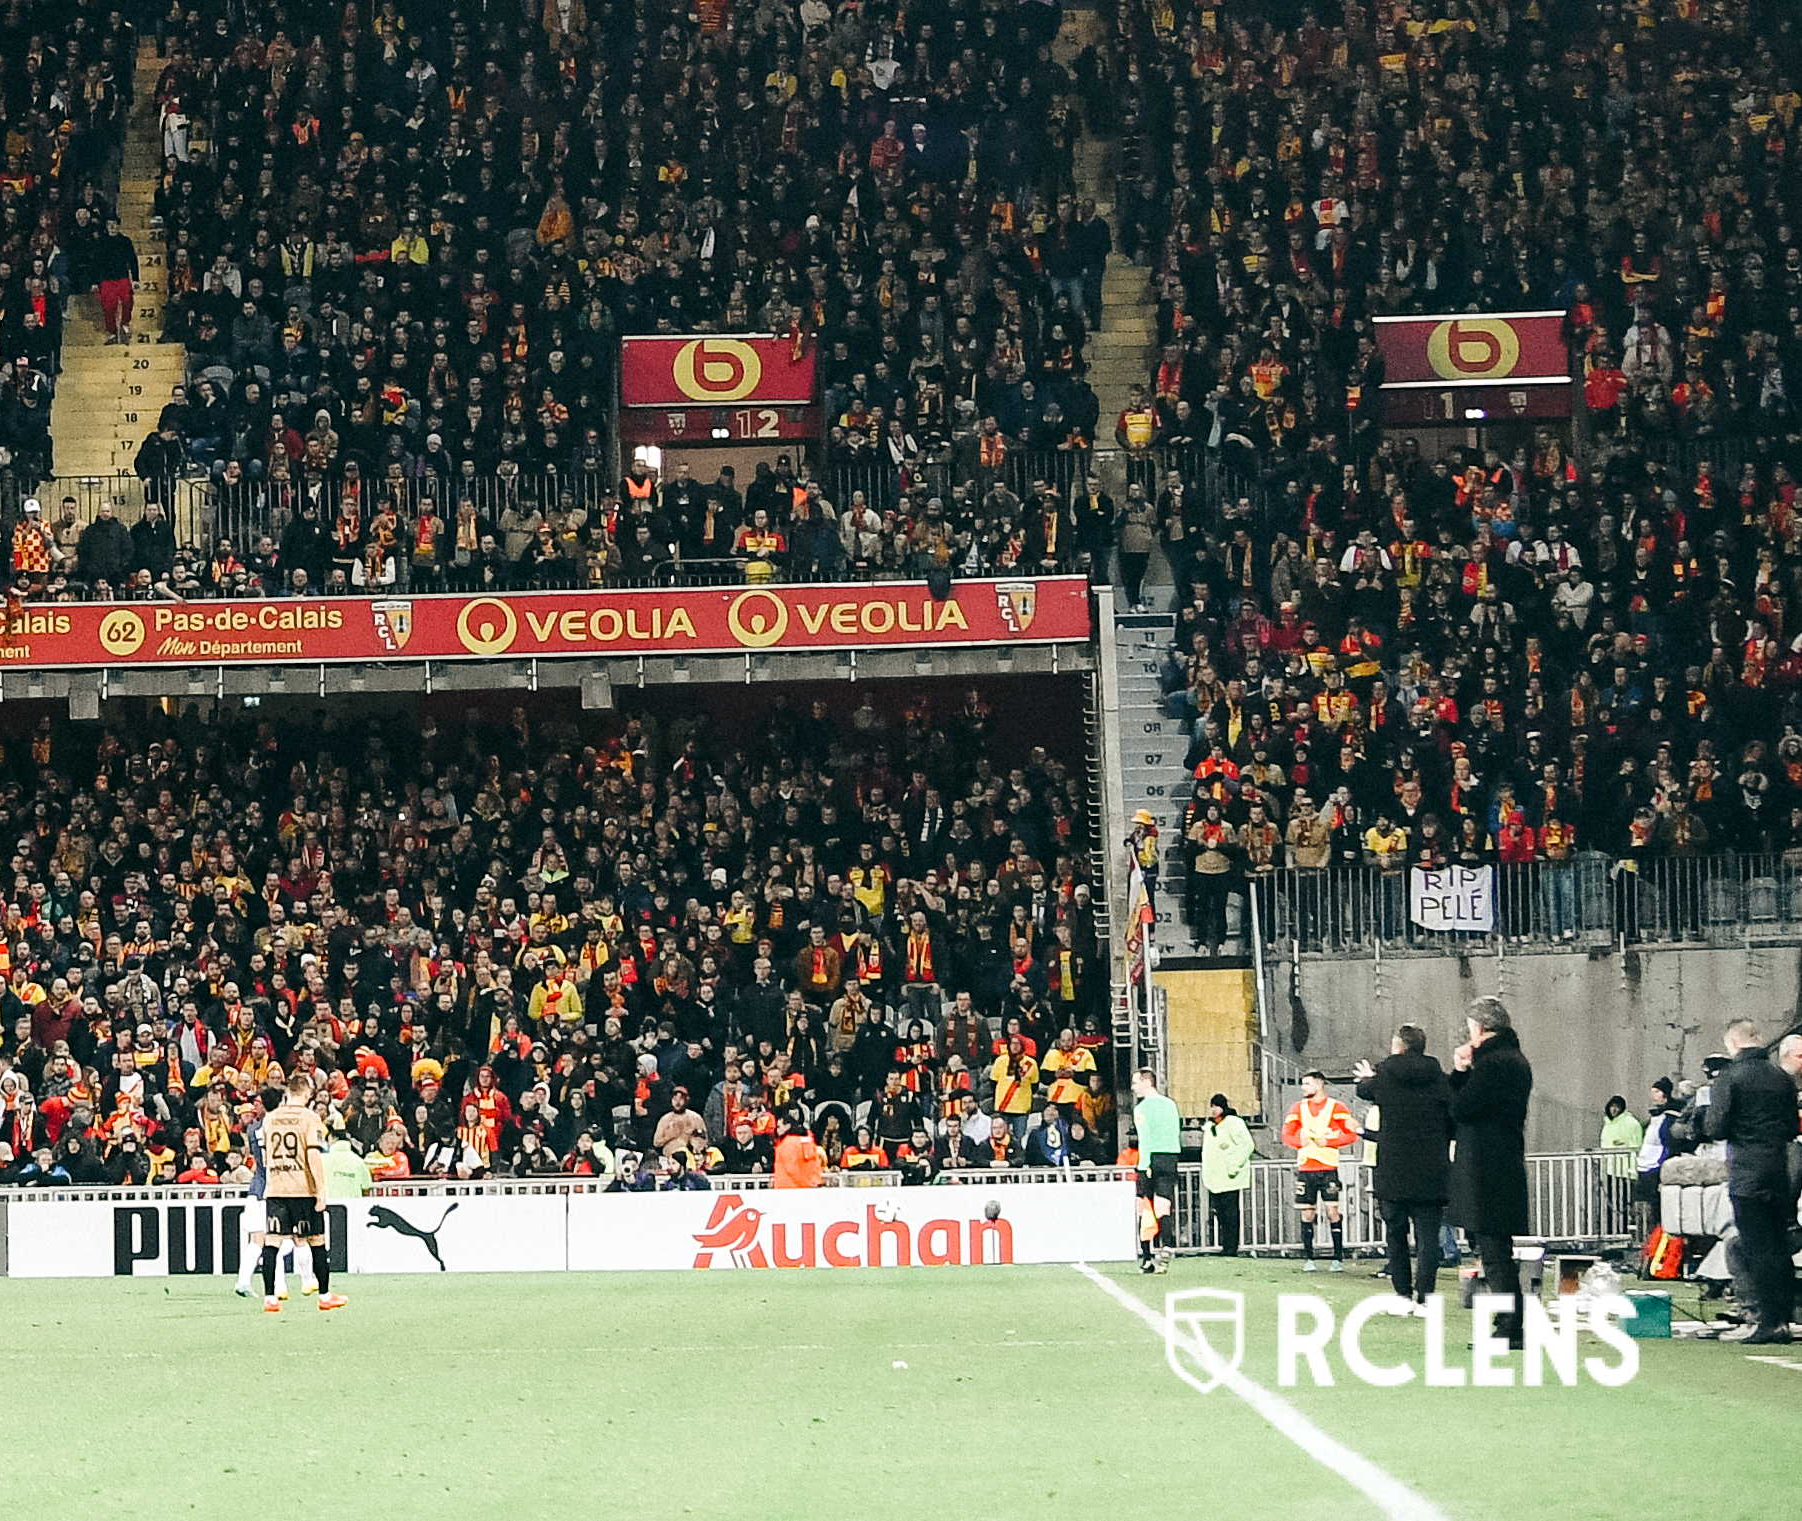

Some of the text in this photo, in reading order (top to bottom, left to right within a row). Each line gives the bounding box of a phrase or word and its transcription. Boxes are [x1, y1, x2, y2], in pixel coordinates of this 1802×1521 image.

[133, 359, 149, 369] 20
[129, 385, 142, 395] 19
[125, 413, 138, 423] 18
[121, 441, 134, 450] 17
[525, 606, 696, 642] VEOLIA
[796, 599, 969, 634] VEOLIA
[108, 621, 138, 643] 62
[156, 636, 303, 659] Mon Département
[1146, 786, 1164, 796] 06
[1424, 869, 1478, 890] RIP
[1420, 887, 1484, 923] PELÉ
[270, 1131, 298, 1160] 29
[113, 1205, 348, 1276] PU
[692, 1194, 1013, 1269] Auchan
